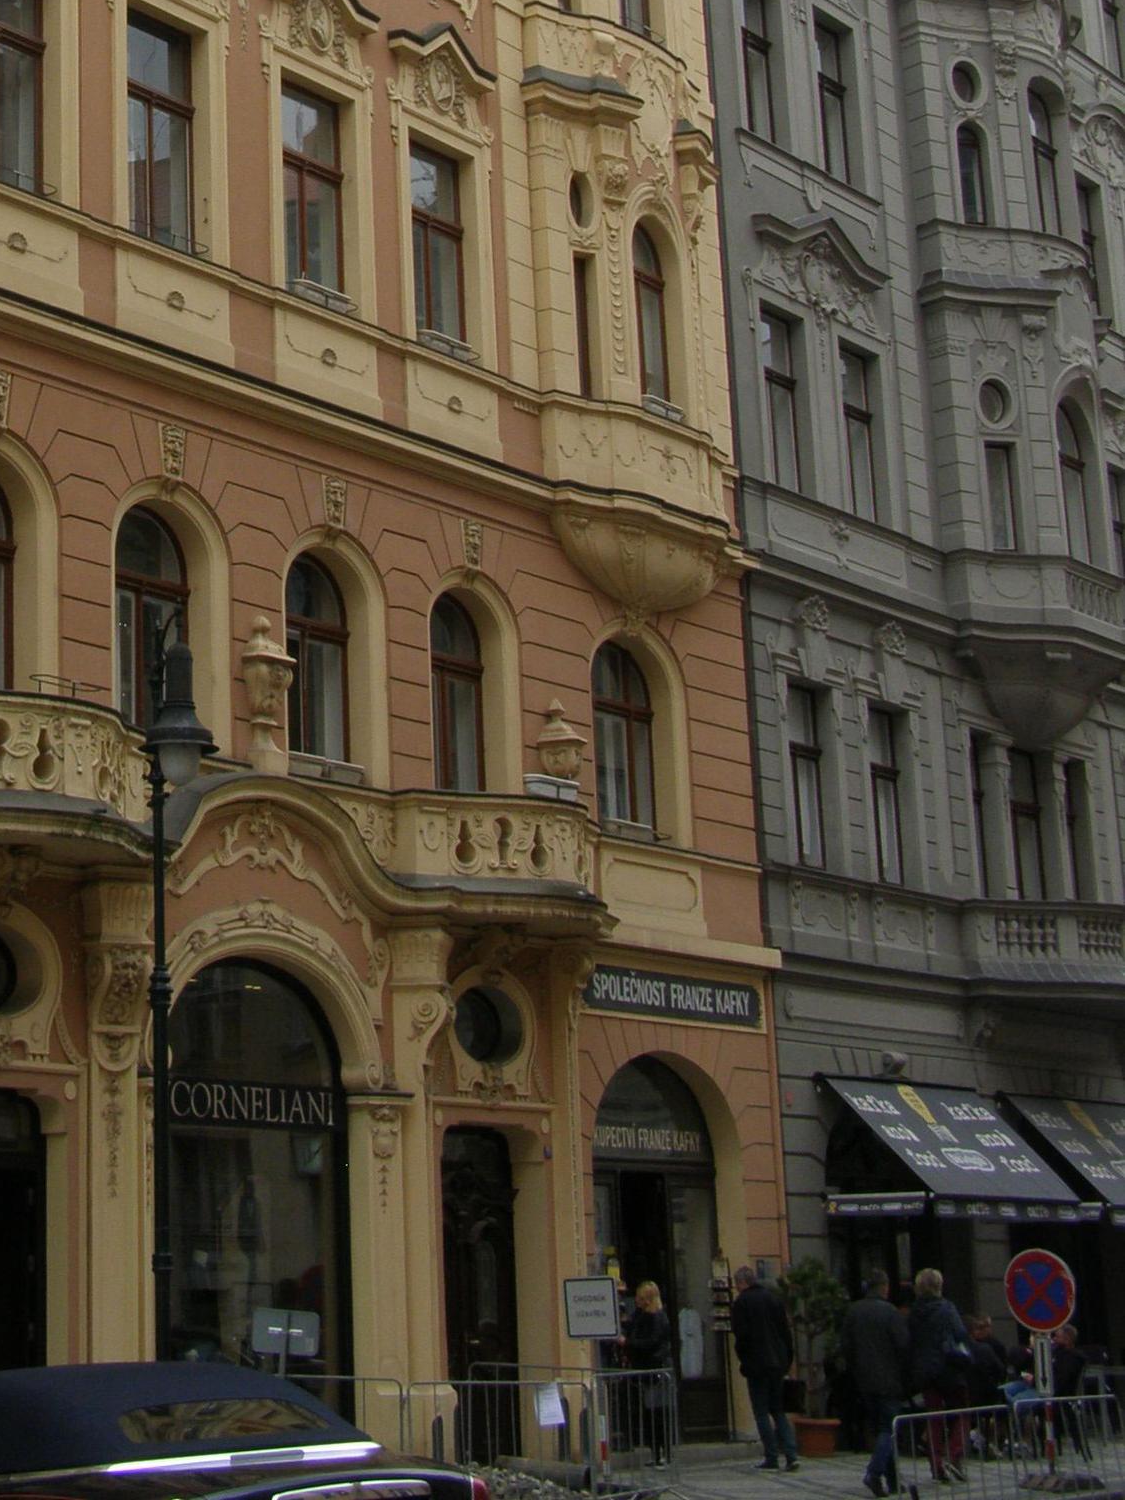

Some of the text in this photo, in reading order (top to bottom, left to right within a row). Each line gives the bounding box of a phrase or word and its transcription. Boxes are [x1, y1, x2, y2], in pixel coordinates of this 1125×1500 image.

[592, 970, 750, 1017] SPOLEČNOST FRANZE KAFKY
[170, 1080, 335, 1127] CORNELIANI
